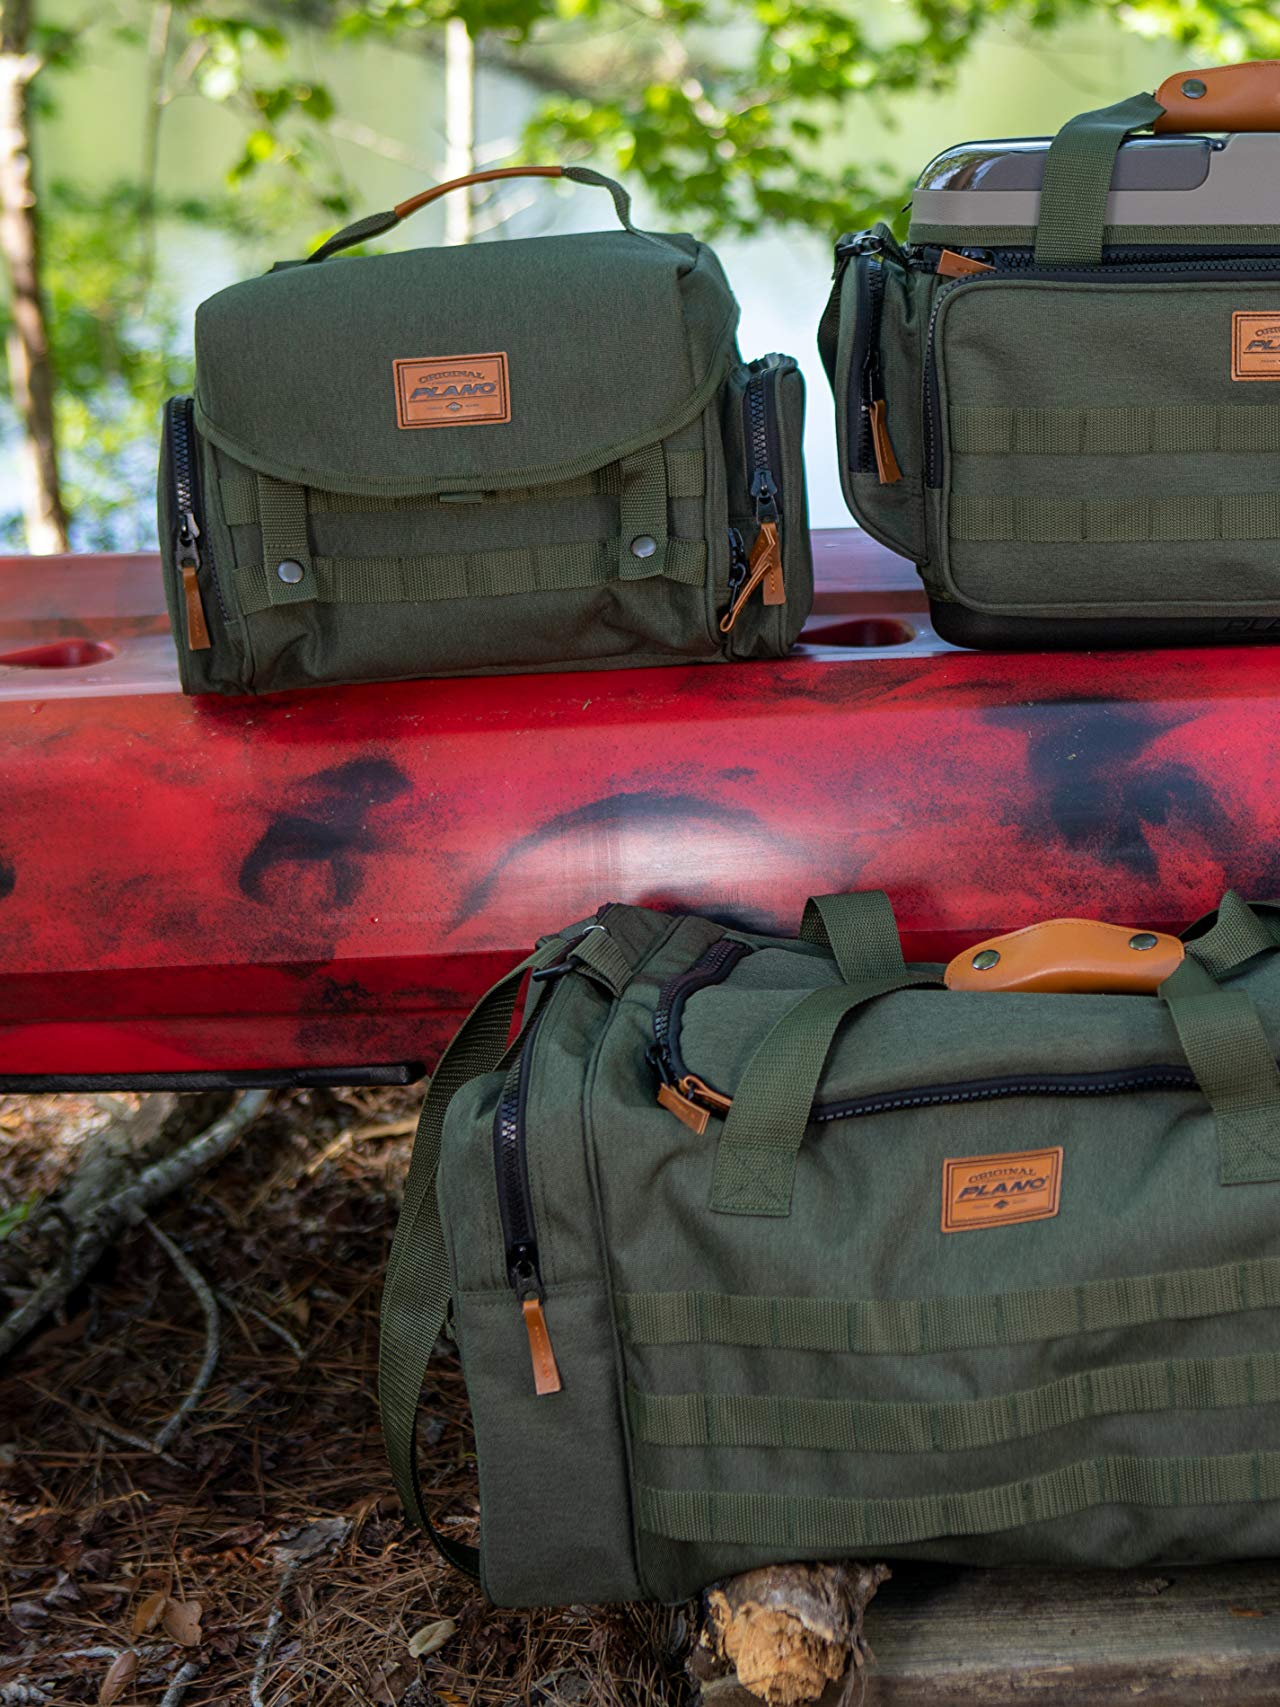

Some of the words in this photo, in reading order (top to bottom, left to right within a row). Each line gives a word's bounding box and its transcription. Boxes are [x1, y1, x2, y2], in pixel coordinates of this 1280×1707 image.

[418, 370, 485, 384] ORIGINAL
[410, 381, 497, 400] PLANO
[968, 1167, 1038, 1184] ORIGINAL
[958, 1177, 1047, 1200] PLANO
